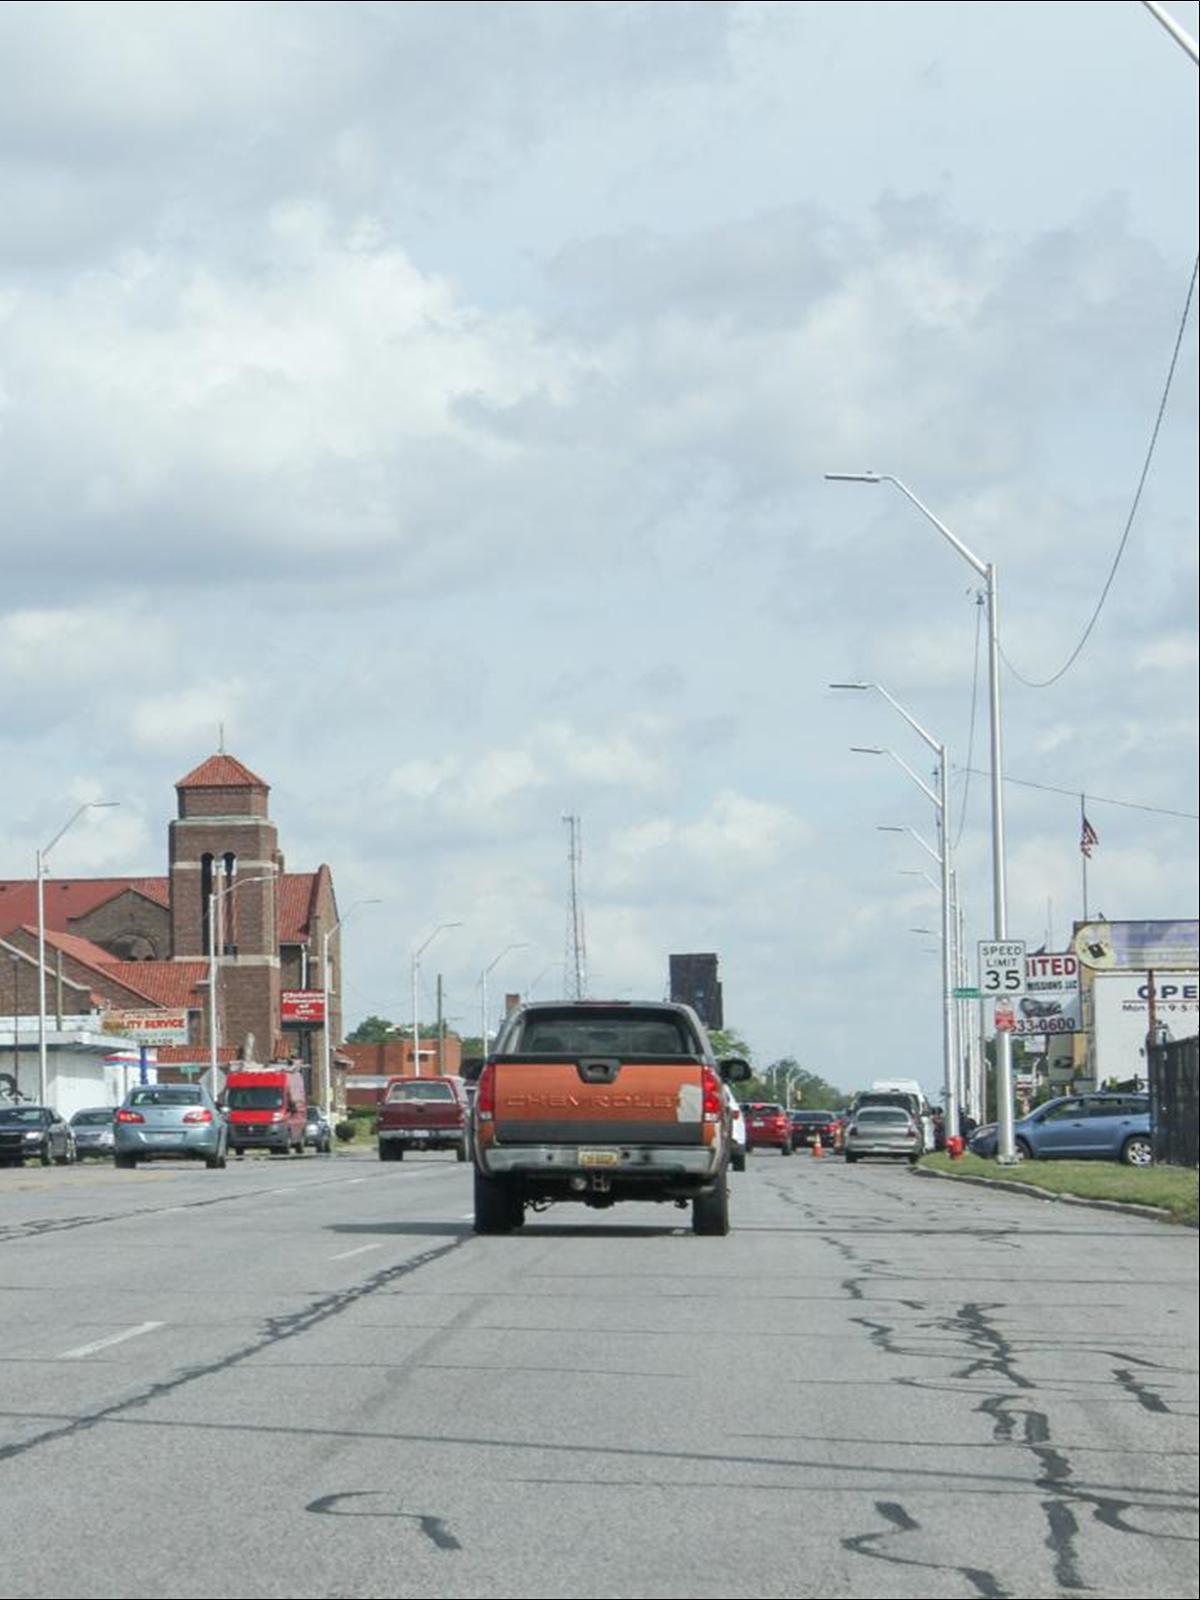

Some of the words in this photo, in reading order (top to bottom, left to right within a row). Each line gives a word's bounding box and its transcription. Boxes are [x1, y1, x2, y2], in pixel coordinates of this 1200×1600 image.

[982, 945, 1022, 956] SPEED
[986, 958, 1017, 968] LIMIT
[1026, 957, 1077, 977] ITED
[985, 970, 1020, 990] 35
[145, 1018, 185, 1029] SERVICE
